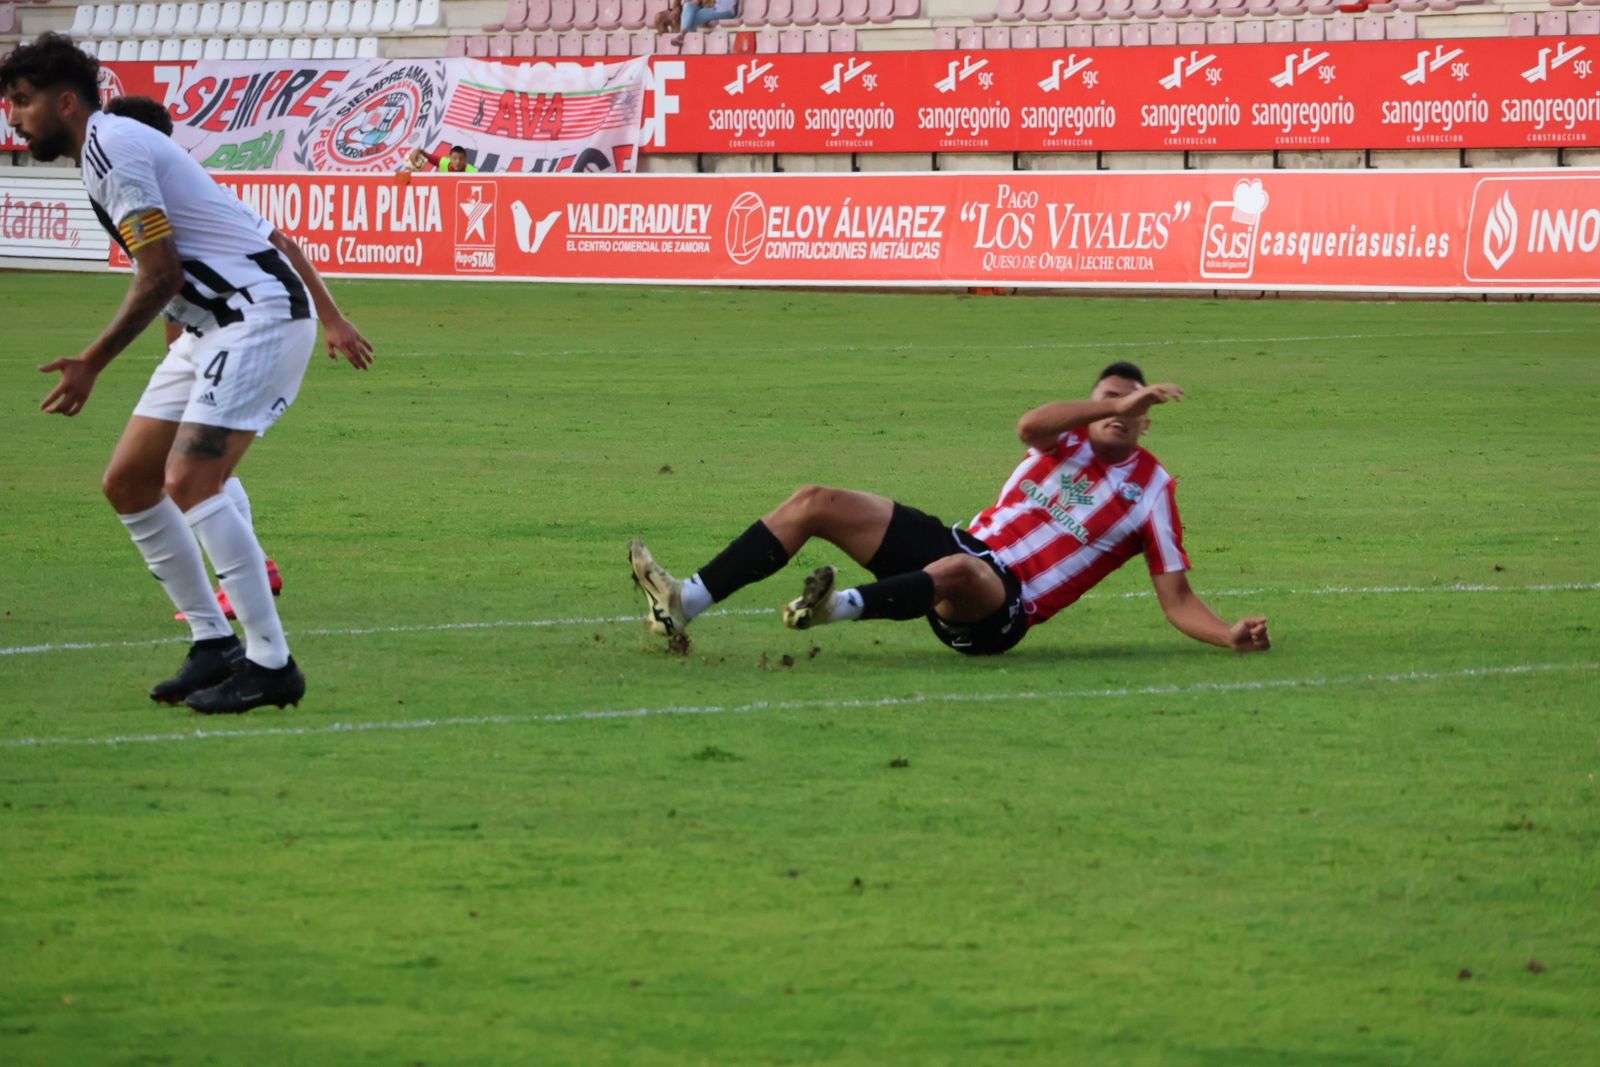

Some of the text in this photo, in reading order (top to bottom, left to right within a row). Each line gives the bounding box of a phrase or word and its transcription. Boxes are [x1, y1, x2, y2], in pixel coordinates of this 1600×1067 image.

[764, 75, 779, 92] sgc
[862, 73, 877, 91] sgc
[978, 72, 993, 90] sgc
[1082, 68, 1098, 89] sgc
[1206, 67, 1222, 86] sgc
[1318, 65, 1335, 84] sgc
[1451, 63, 1469, 81] sgc
[1573, 60, 1592, 79] sgc
[168, 69, 350, 132] SIEMPRE
[1021, 100, 1115, 135] sangregorio
[1141, 98, 1240, 134] sangregorio
[1252, 96, 1354, 133] sangregorio
[1382, 93, 1488, 131] sangregorio
[709, 103, 794, 137] sangregorio
[805, 102, 894, 136] sangregorio
[918, 101, 1010, 136] sangregorio
[0, 192, 67, 240] tania
[219, 183, 442, 232] MINO DE LA PLATA
[567, 203, 712, 233] VALDERADUEY
[766, 197, 946, 238] ELOY ÁLVAREZ
[337, 237, 422, 266] (Zamora)
[566, 240, 710, 253] EL CENTRO COMERCIAL DE ZAMORA
[869, 238, 940, 260] METÁLICAS
[1206, 223, 1251, 259] Susi
[1260, 225, 1449, 264] casqueriasusi.es
[1080, 256, 1114, 270] LECHE
[1115, 256, 1154, 270] CRUDA
[204, 350, 229, 387] 4
[1020, 479, 1091, 545] CAJA RURAL
